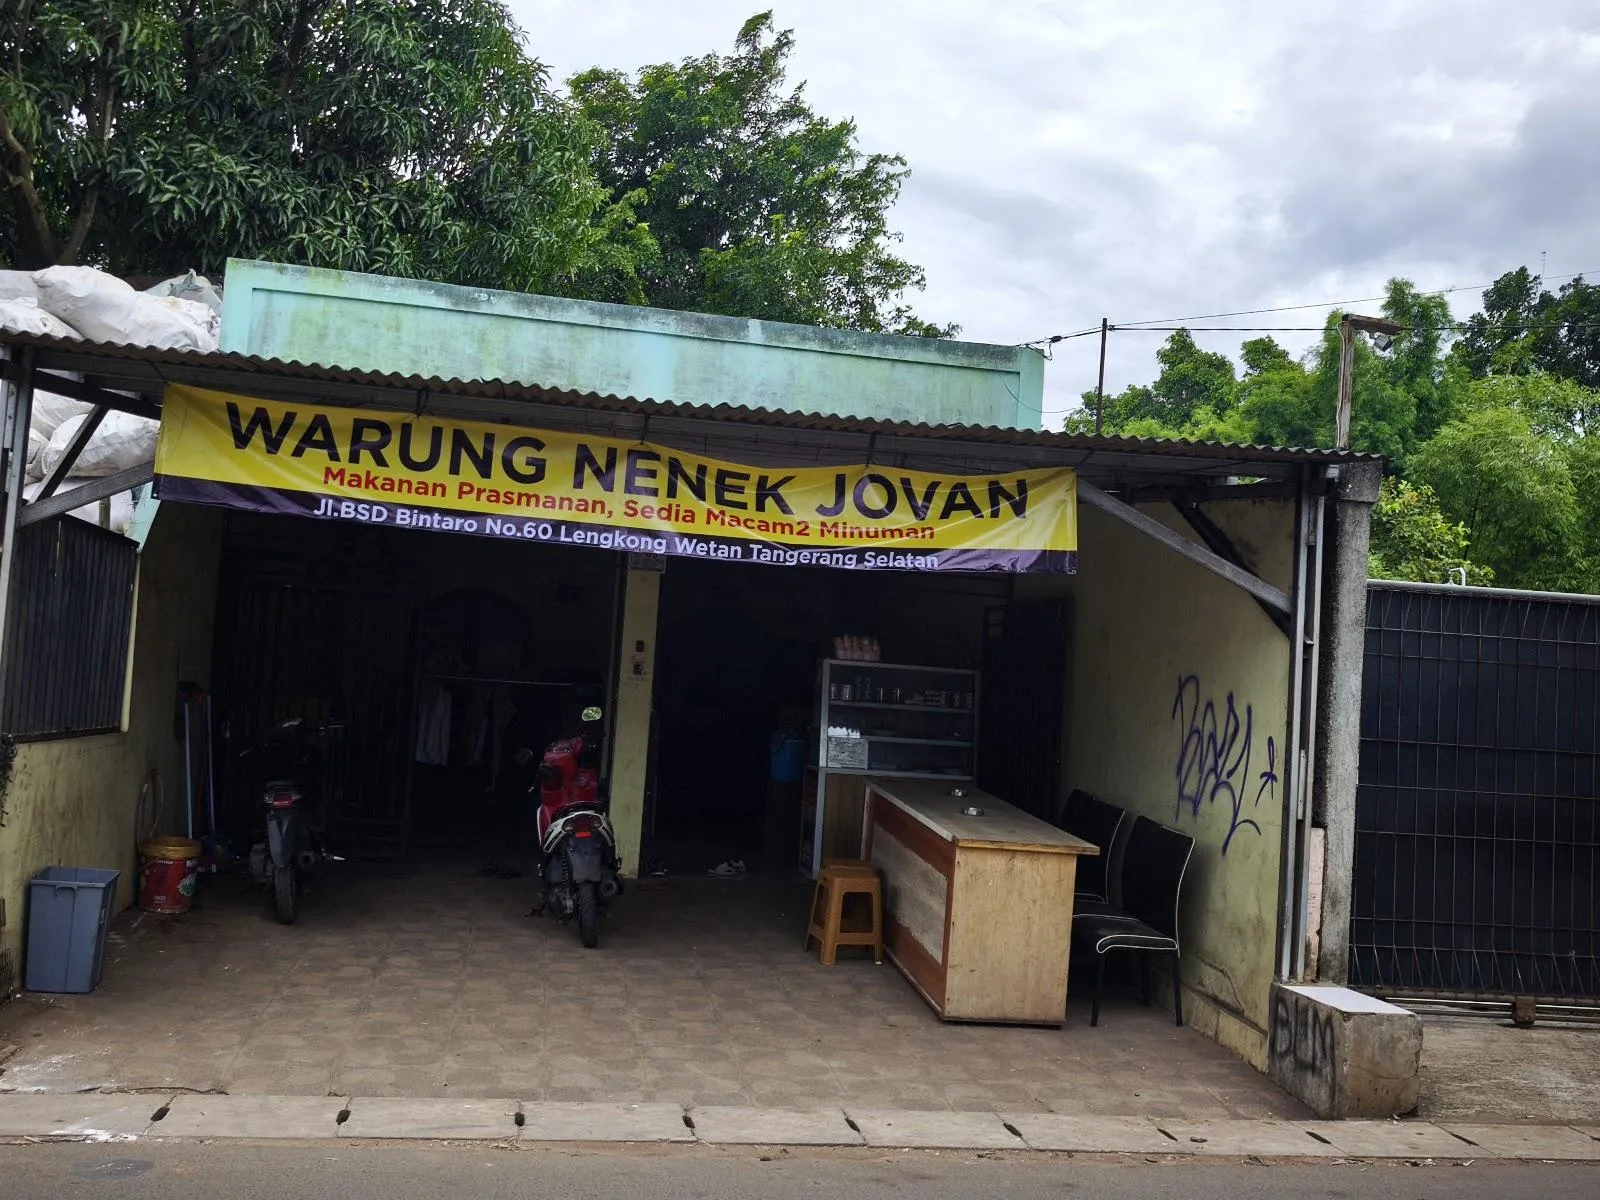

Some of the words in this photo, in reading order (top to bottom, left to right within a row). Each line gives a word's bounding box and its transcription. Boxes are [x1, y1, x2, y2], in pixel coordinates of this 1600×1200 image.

[225, 401, 547, 485] WARUNG
[572, 443, 798, 516] NENEK
[815, 473, 1028, 521] JOVAN
[313, 499, 388, 522] Jl.BSD
[396, 508, 477, 533] Bintaro
[486, 518, 552, 540] No.60
[560, 525, 667, 553] Lengkong
[674, 536, 742, 560] Wetan
[749, 544, 857, 567] Tangerang
[863, 551, 939, 569] Selatan
[323, 466, 447, 498] Makanan
[457, 482, 613, 519] Prasmanan,
[624, 499, 696, 524] Sedia
[706, 507, 811, 537] Macam2
[820, 520, 935, 540] Minuman
